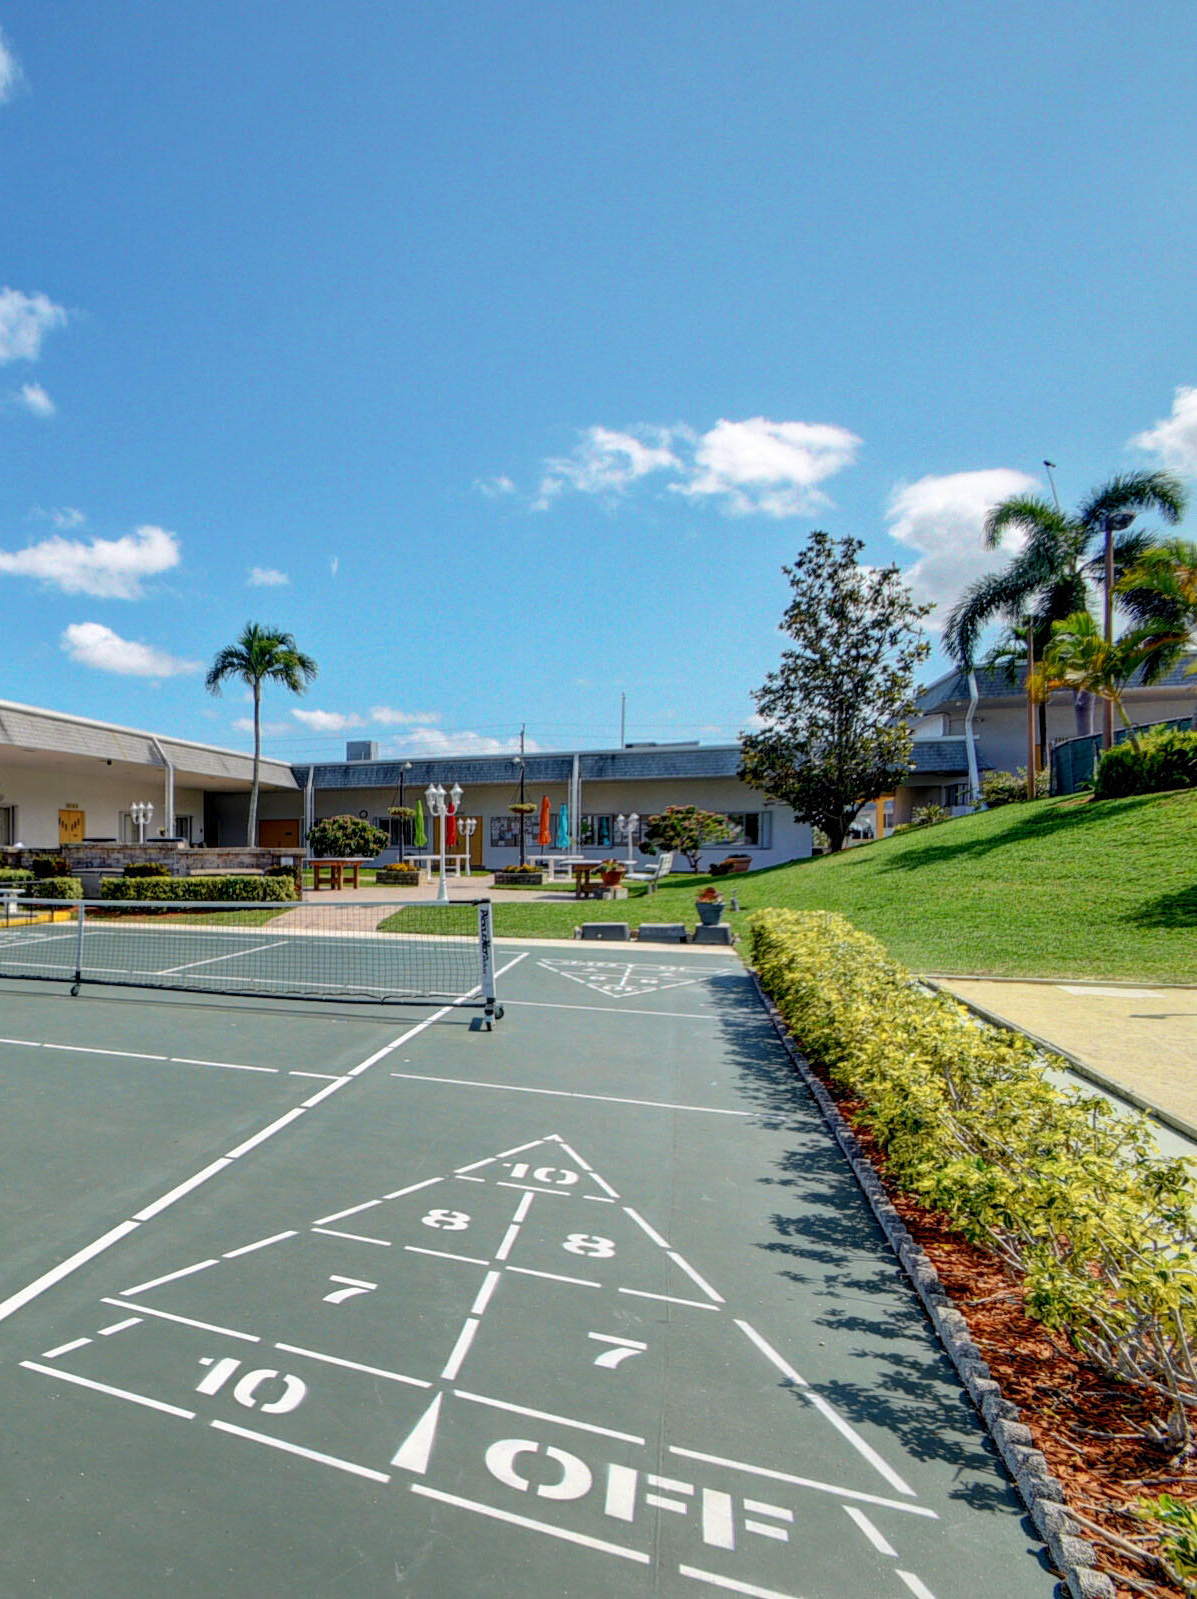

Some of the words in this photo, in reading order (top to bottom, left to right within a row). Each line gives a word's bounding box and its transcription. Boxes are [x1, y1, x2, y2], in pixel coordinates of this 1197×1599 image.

[502, 1162, 580, 1185] 10
[421, 1208, 472, 1231] 8
[562, 1232, 617, 1258] 8
[322, 1274, 379, 1304] 7
[587, 1331, 648, 1370] 7
[195, 1357, 307, 1414] 10
[484, 1438, 795, 1551] OFF
